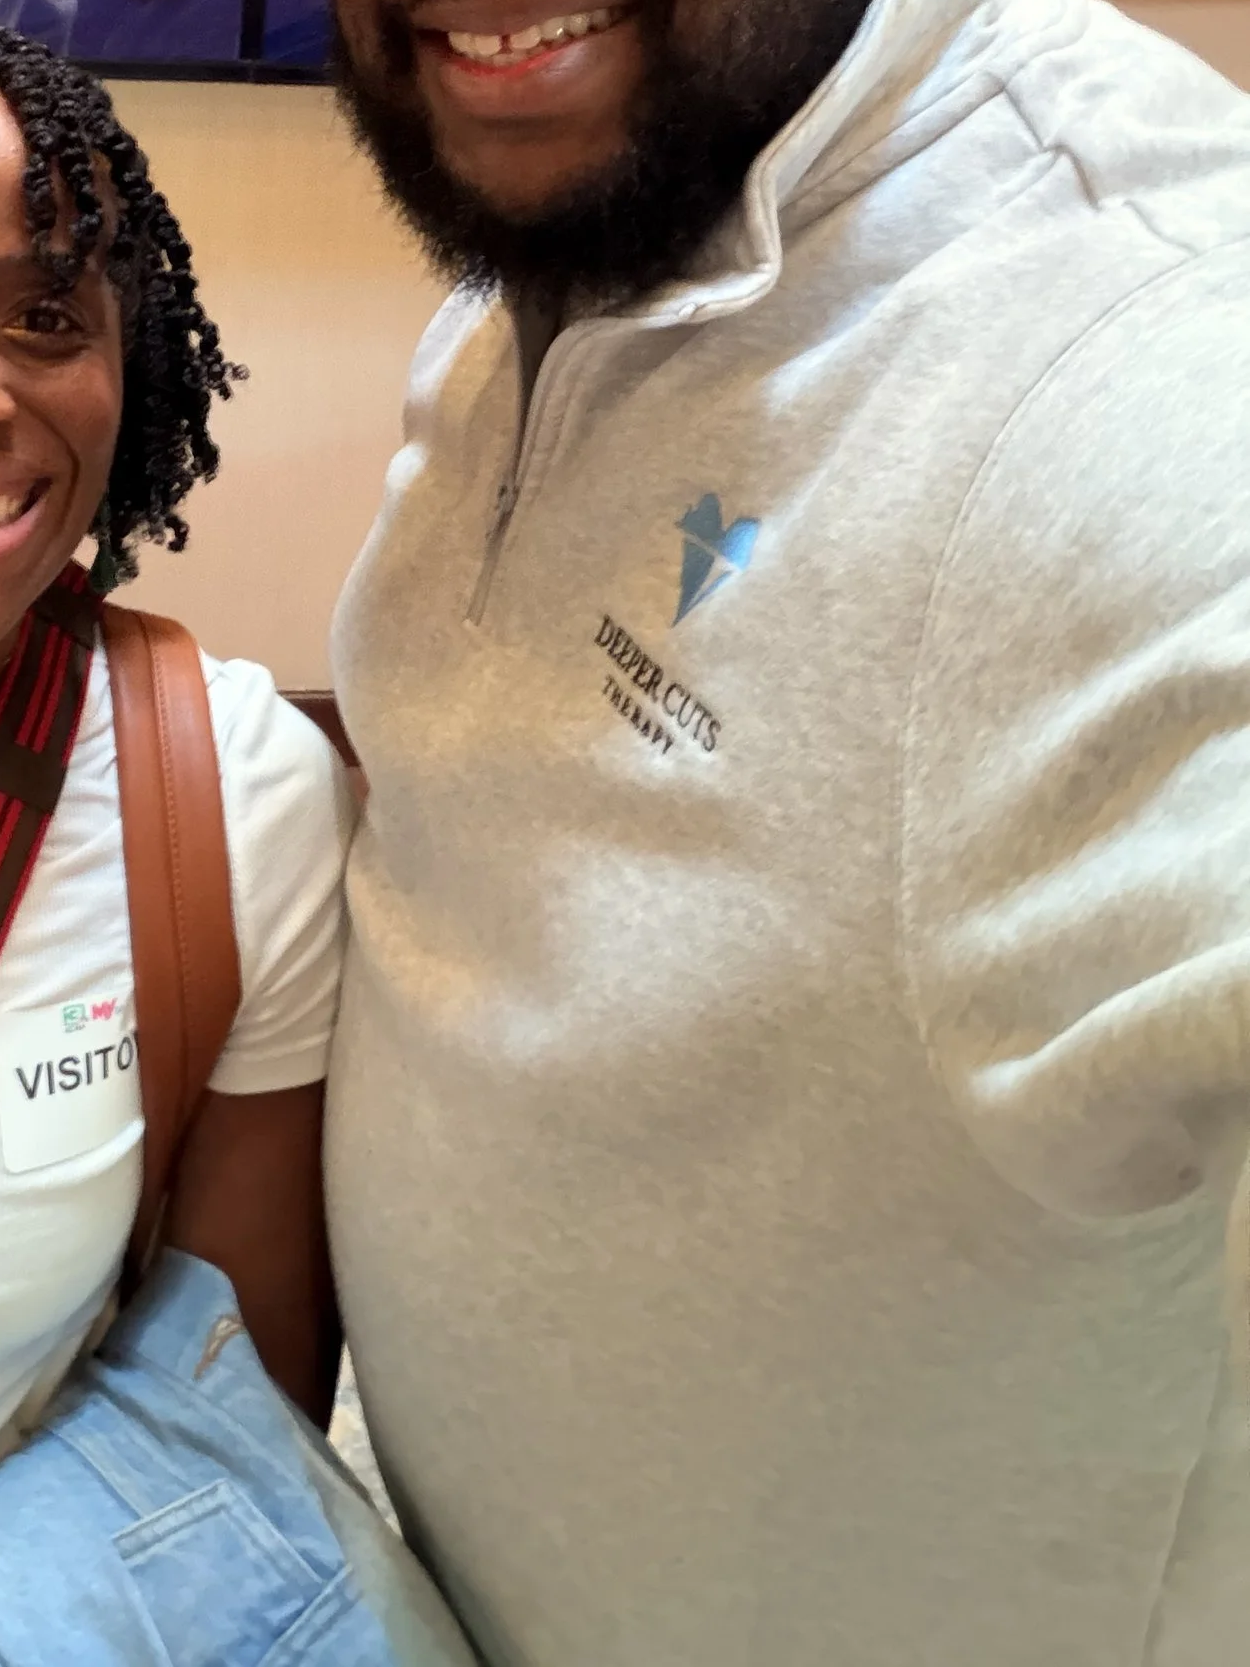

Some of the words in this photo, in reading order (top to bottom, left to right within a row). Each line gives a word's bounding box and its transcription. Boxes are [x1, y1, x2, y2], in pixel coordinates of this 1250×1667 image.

[595, 614, 663, 703] DEEPER
[661, 682, 722, 754] CUTS
[15, 1032, 138, 1100] VISITO
